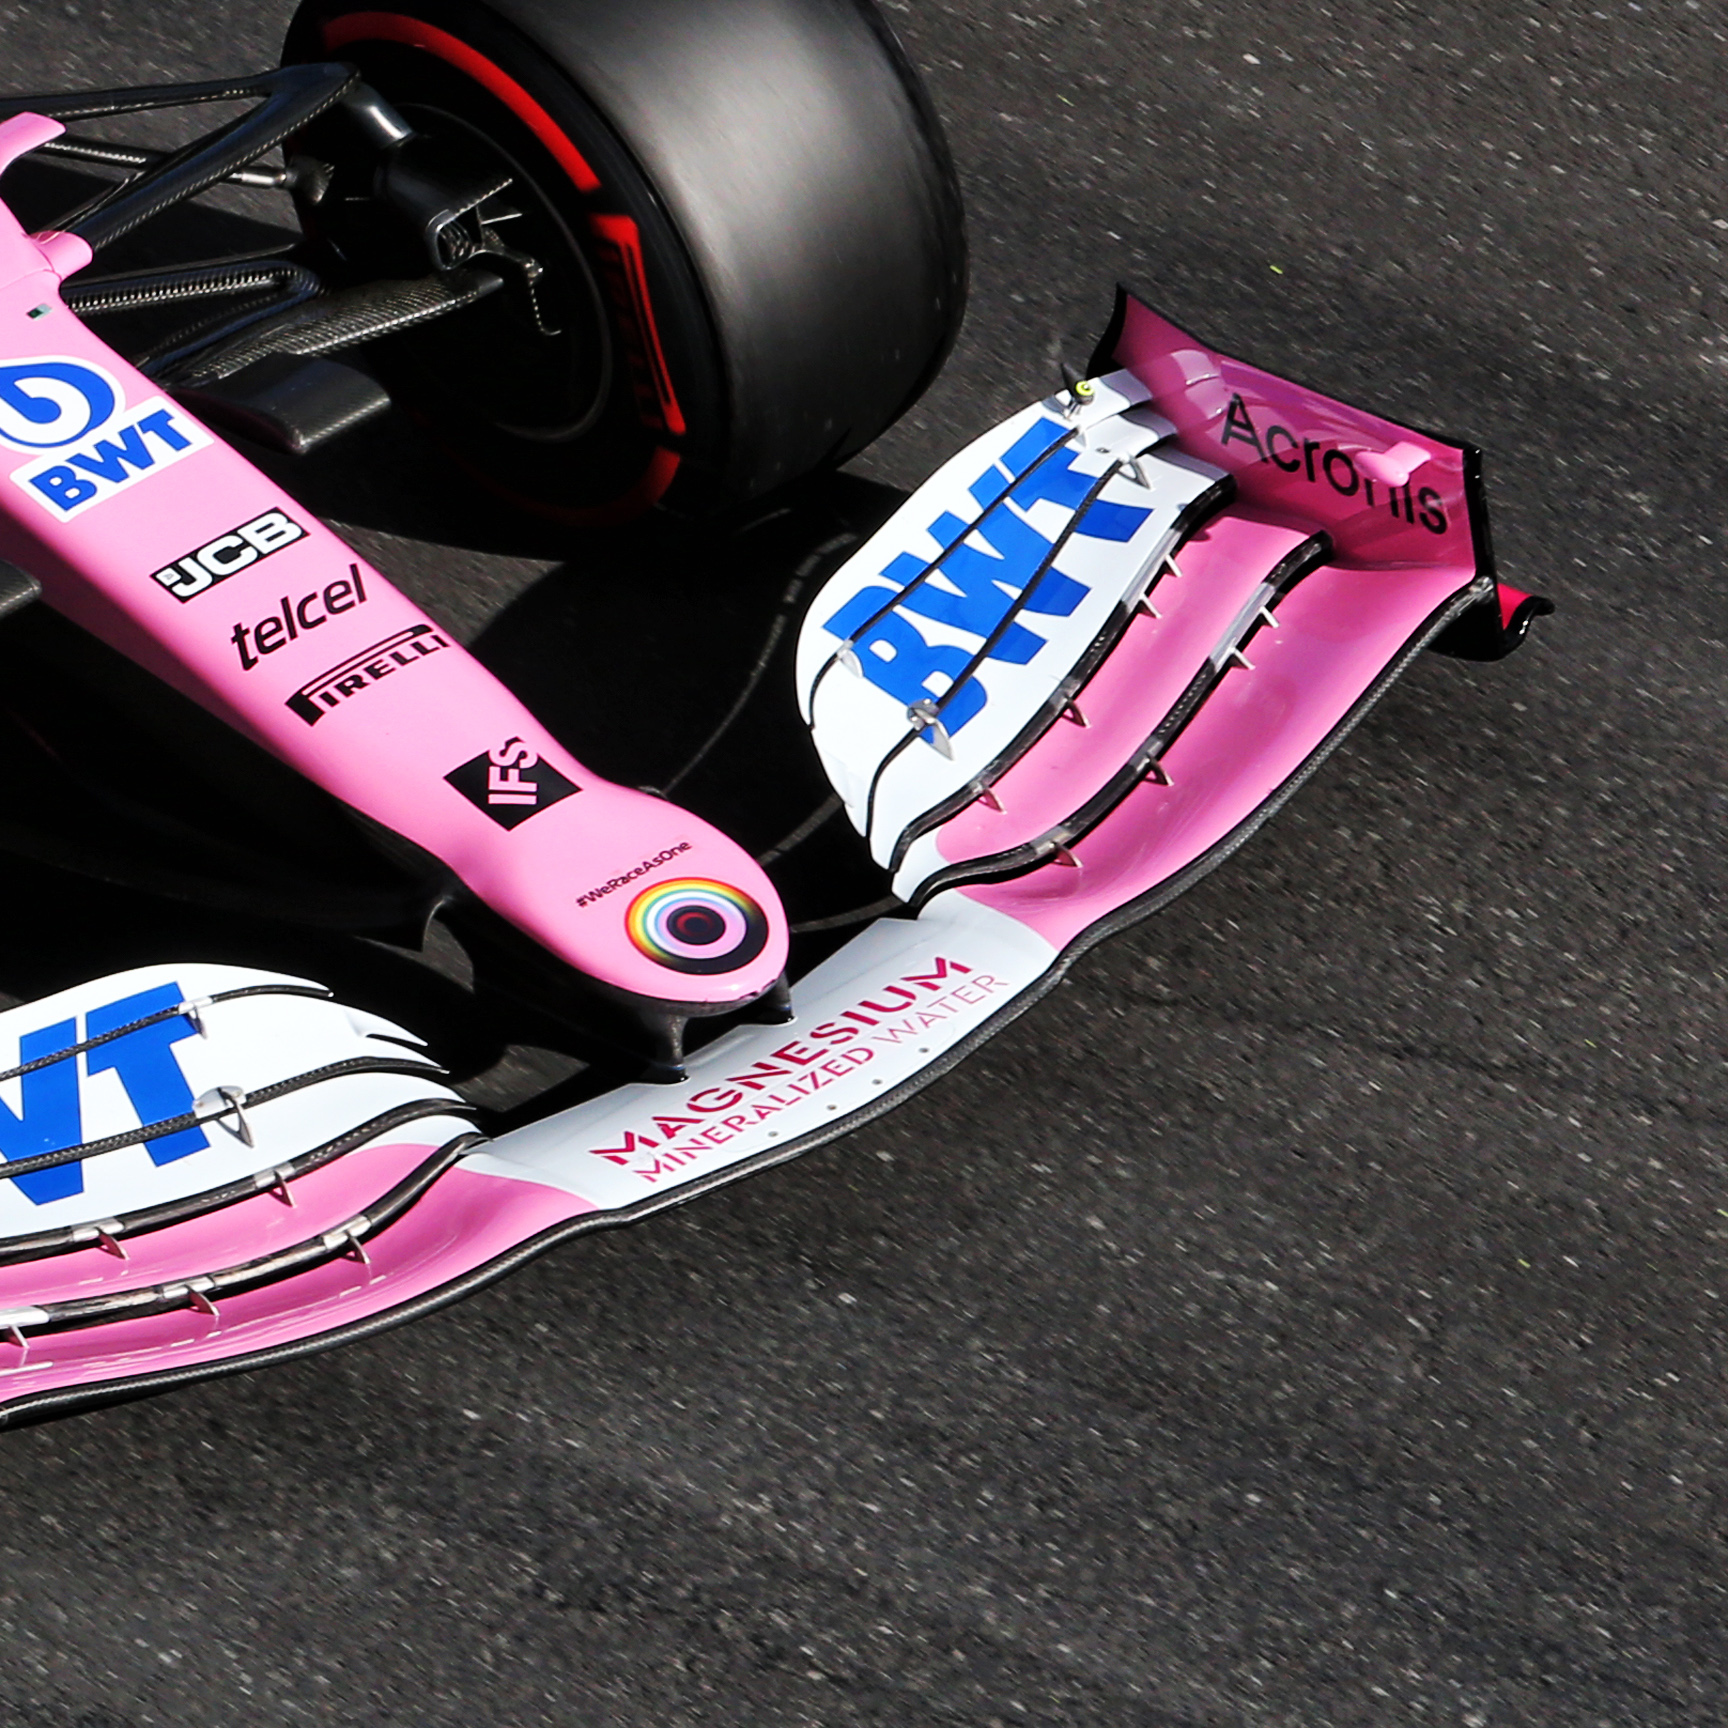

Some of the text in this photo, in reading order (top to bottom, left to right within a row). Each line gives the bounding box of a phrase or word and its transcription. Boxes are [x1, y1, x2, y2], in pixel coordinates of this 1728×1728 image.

[29, 405, 194, 512] BWT
[163, 510, 306, 600] JCB
[822, 416, 1154, 745] BWT
[231, 565, 370, 672] telcel
[285, 623, 450, 727] PIRELLI
[487, 737, 540, 807] IFS
[575, 839, 693, 910] #WeRaceAsOne
[588, 955, 975, 1165] MAGNESIUM
[634, 973, 1011, 1185] MINERALIZED WATER
